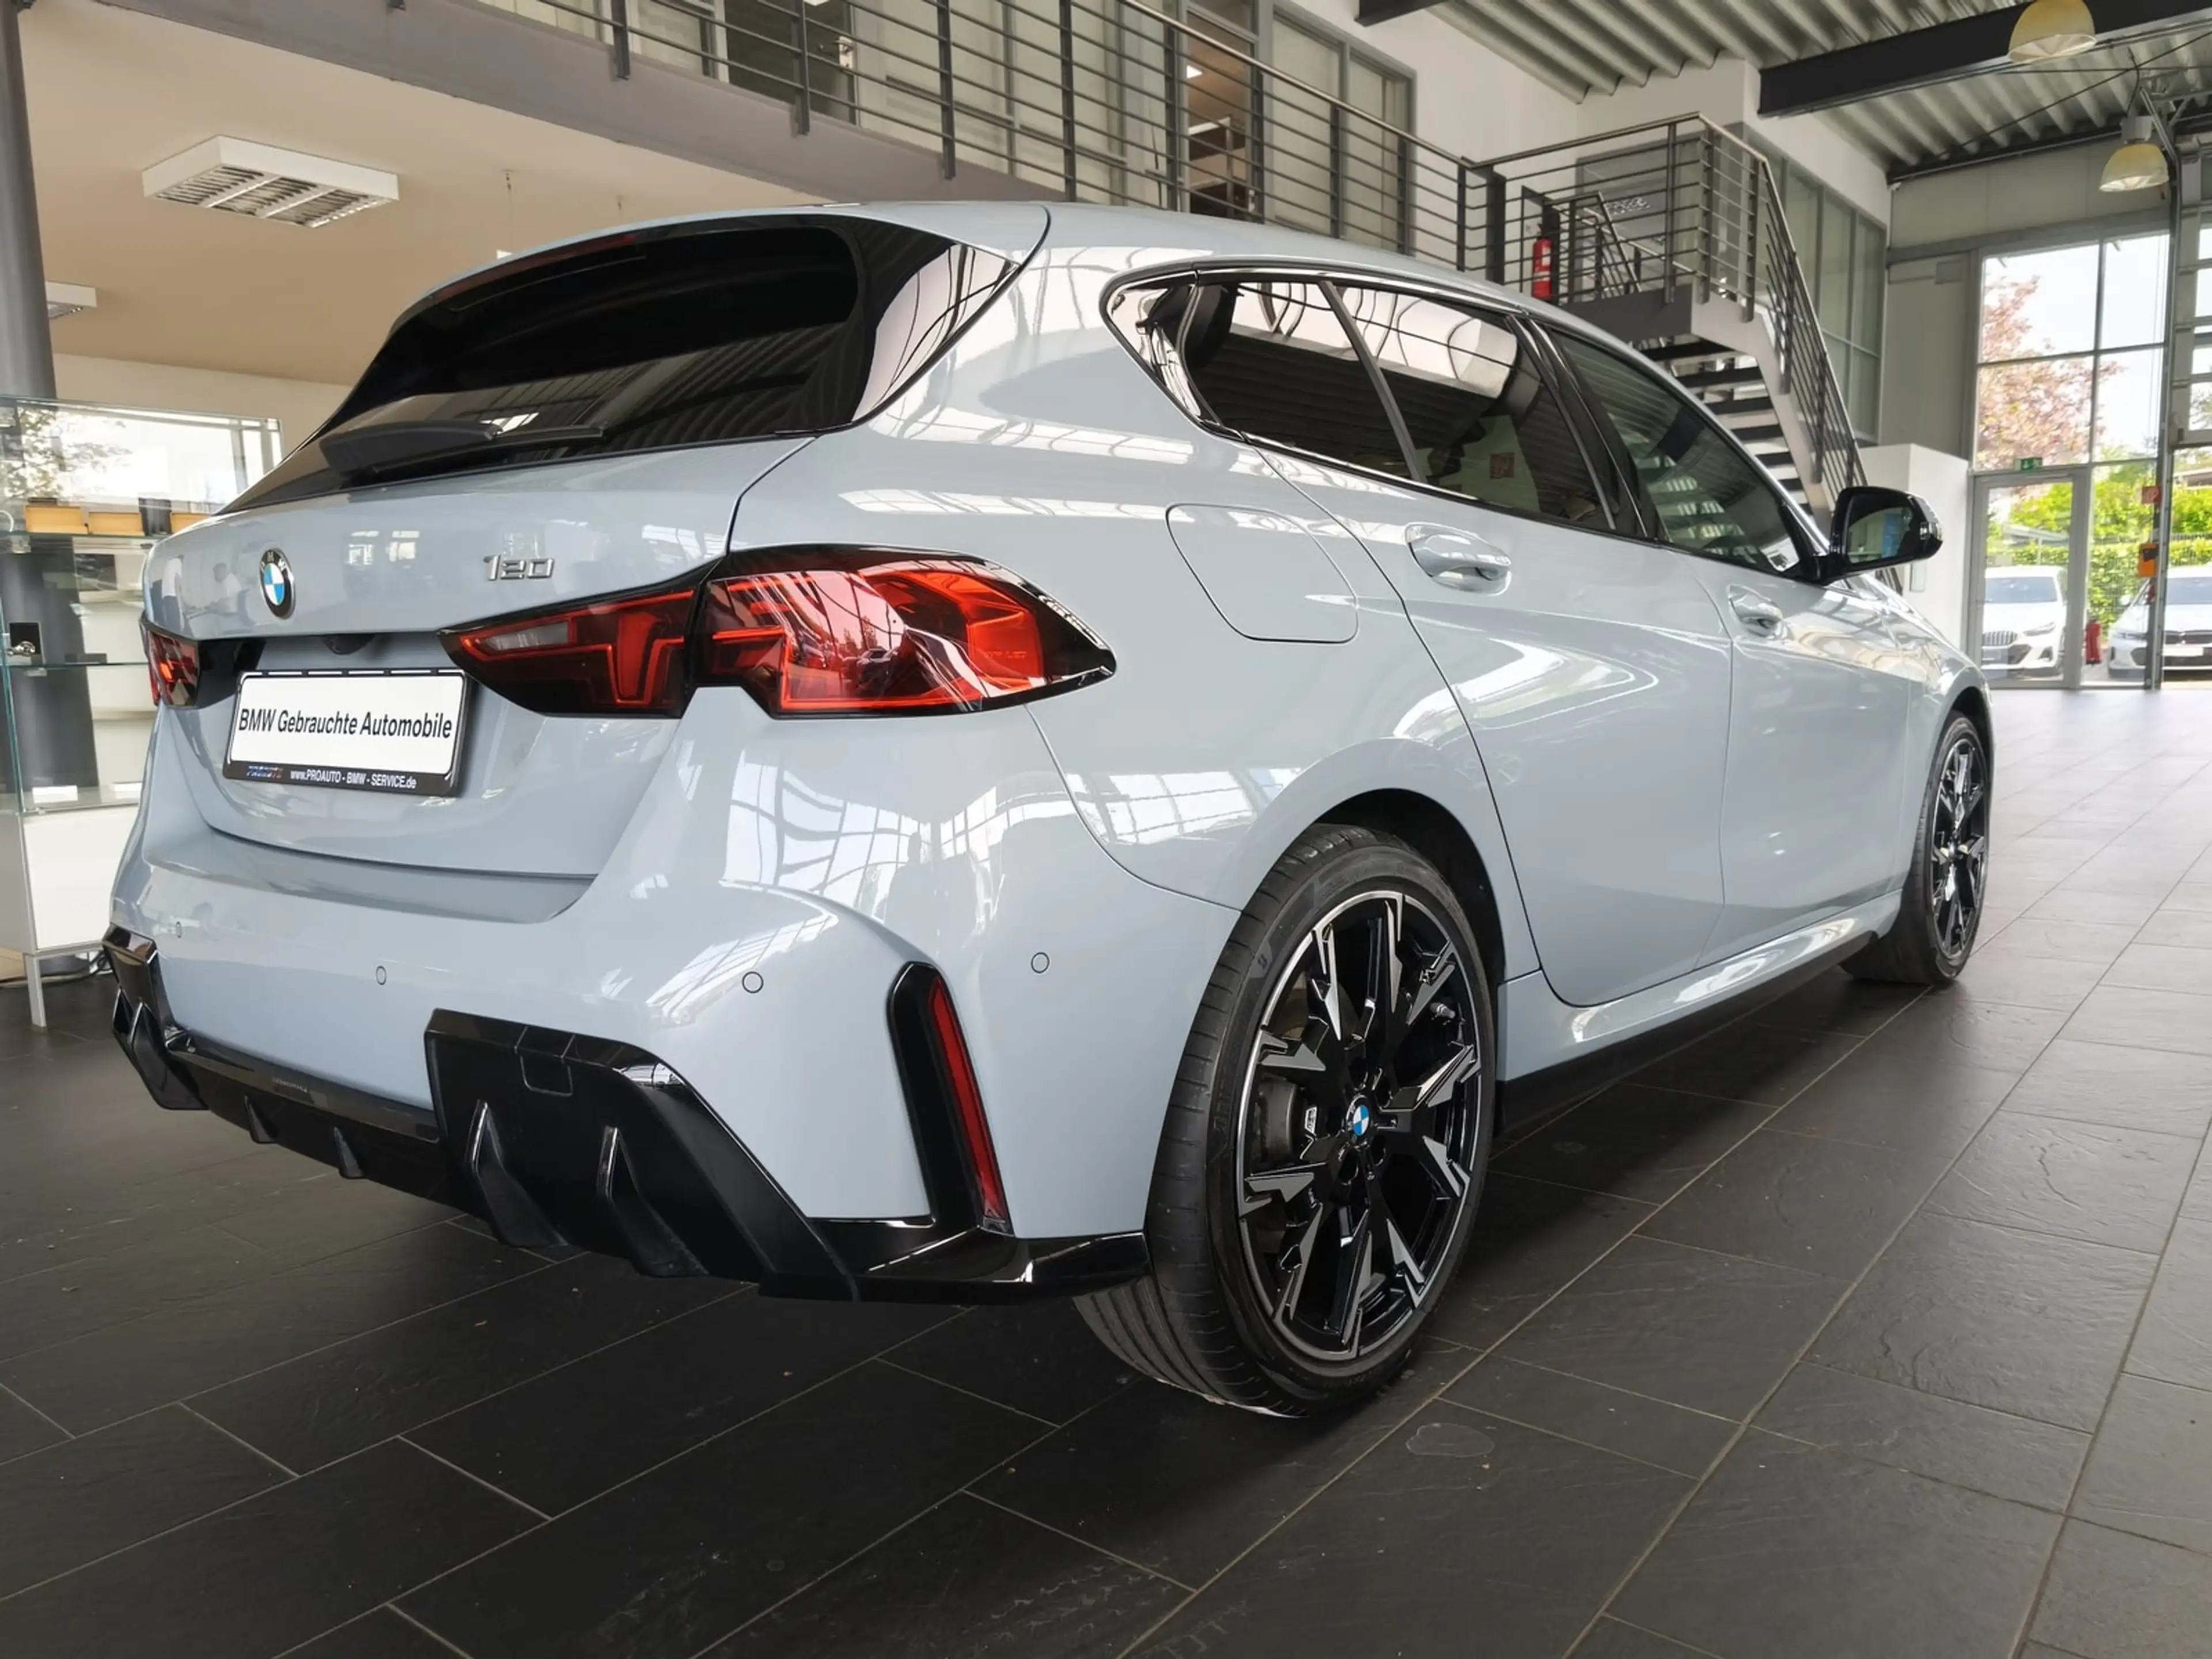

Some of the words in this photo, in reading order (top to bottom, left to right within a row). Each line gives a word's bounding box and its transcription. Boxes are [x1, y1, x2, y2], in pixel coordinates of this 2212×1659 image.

[483, 554, 555, 581] 120
[238, 708, 277, 732] BMW
[278, 709, 358, 735] Gebrauchte
[359, 711, 452, 738] Automobile
